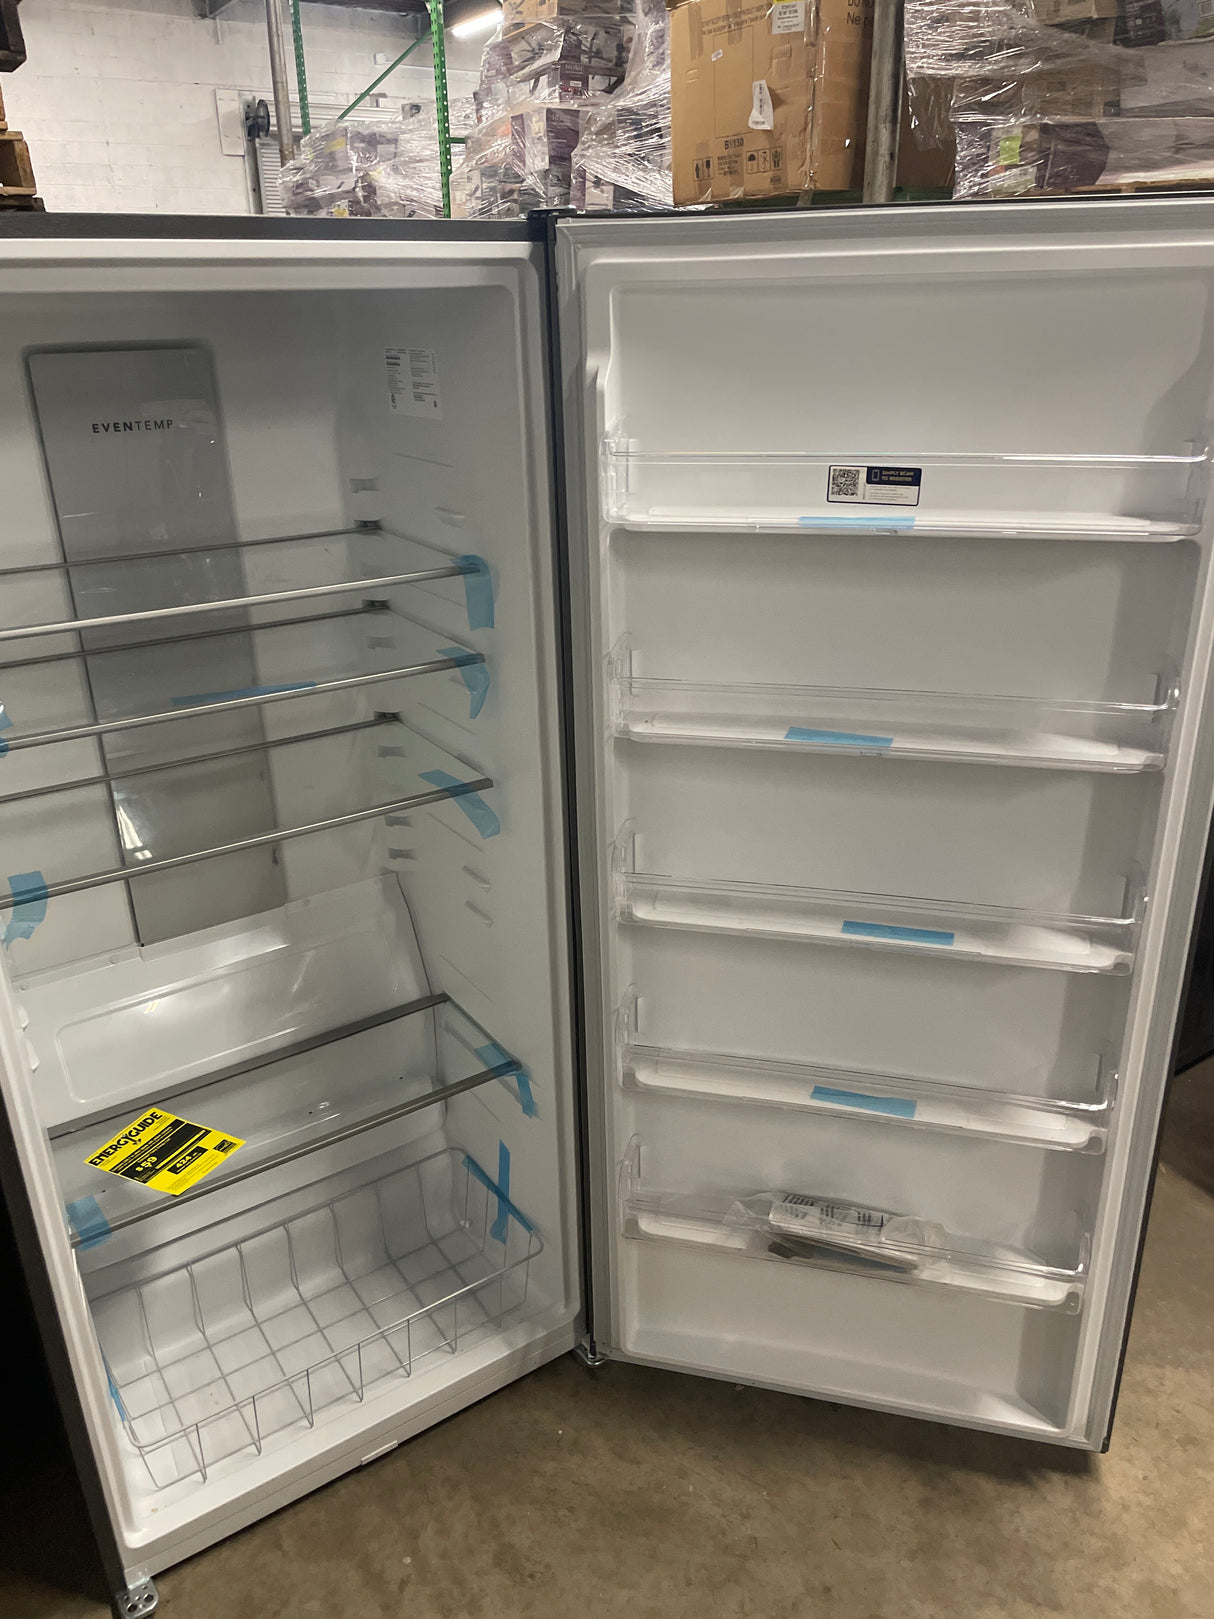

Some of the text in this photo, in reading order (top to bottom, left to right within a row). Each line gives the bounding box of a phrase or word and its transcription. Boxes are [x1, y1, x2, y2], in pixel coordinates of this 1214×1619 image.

[847, 12, 861, 25] Ne
[92, 419, 174, 434] EVENTEMP
[88, 1111, 163, 1166] ENERGYGUIDE
